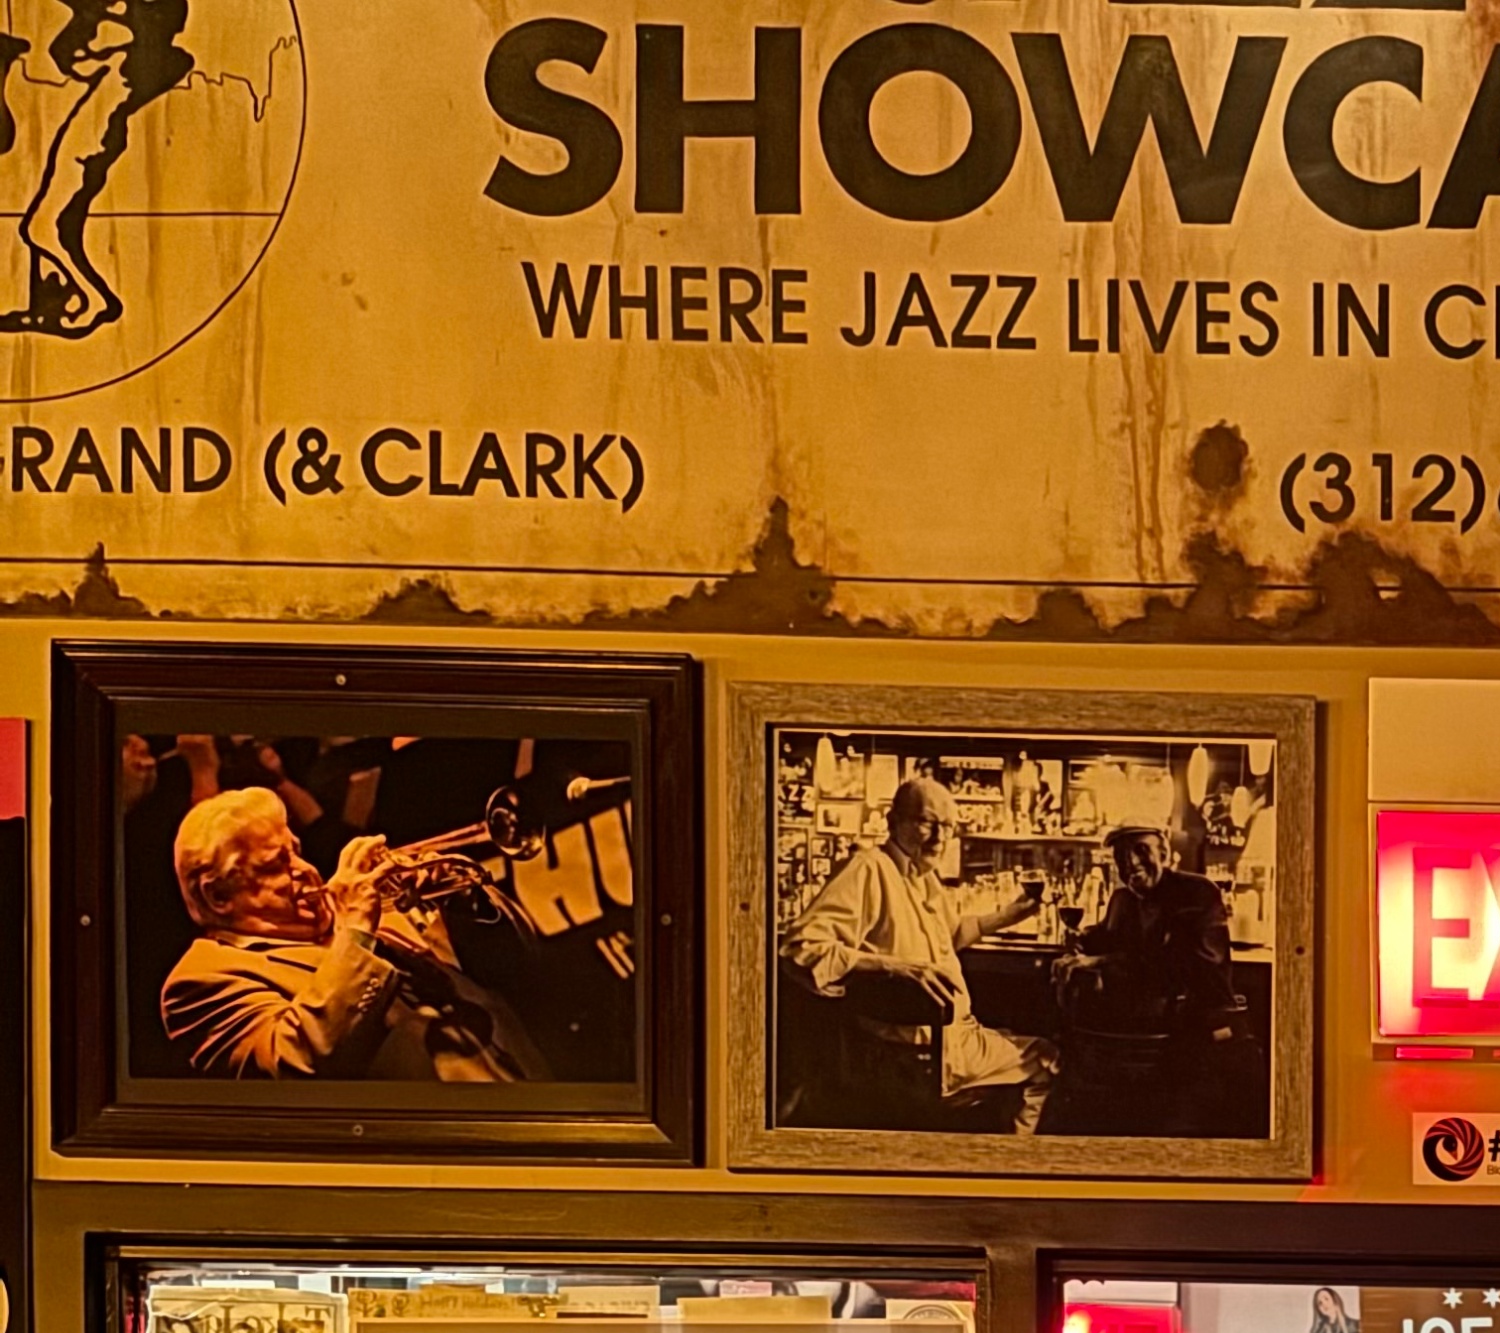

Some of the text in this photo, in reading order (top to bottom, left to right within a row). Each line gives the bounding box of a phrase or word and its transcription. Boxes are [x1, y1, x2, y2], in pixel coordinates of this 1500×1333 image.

[521, 261, 809, 346] WHERE
[840, 270, 1036, 350] JAZZ
[1066, 278, 1280, 357] LIVES
[1310, 282, 1390, 359] IN
[0, 427, 645, 513] RAND (& CLARK)
